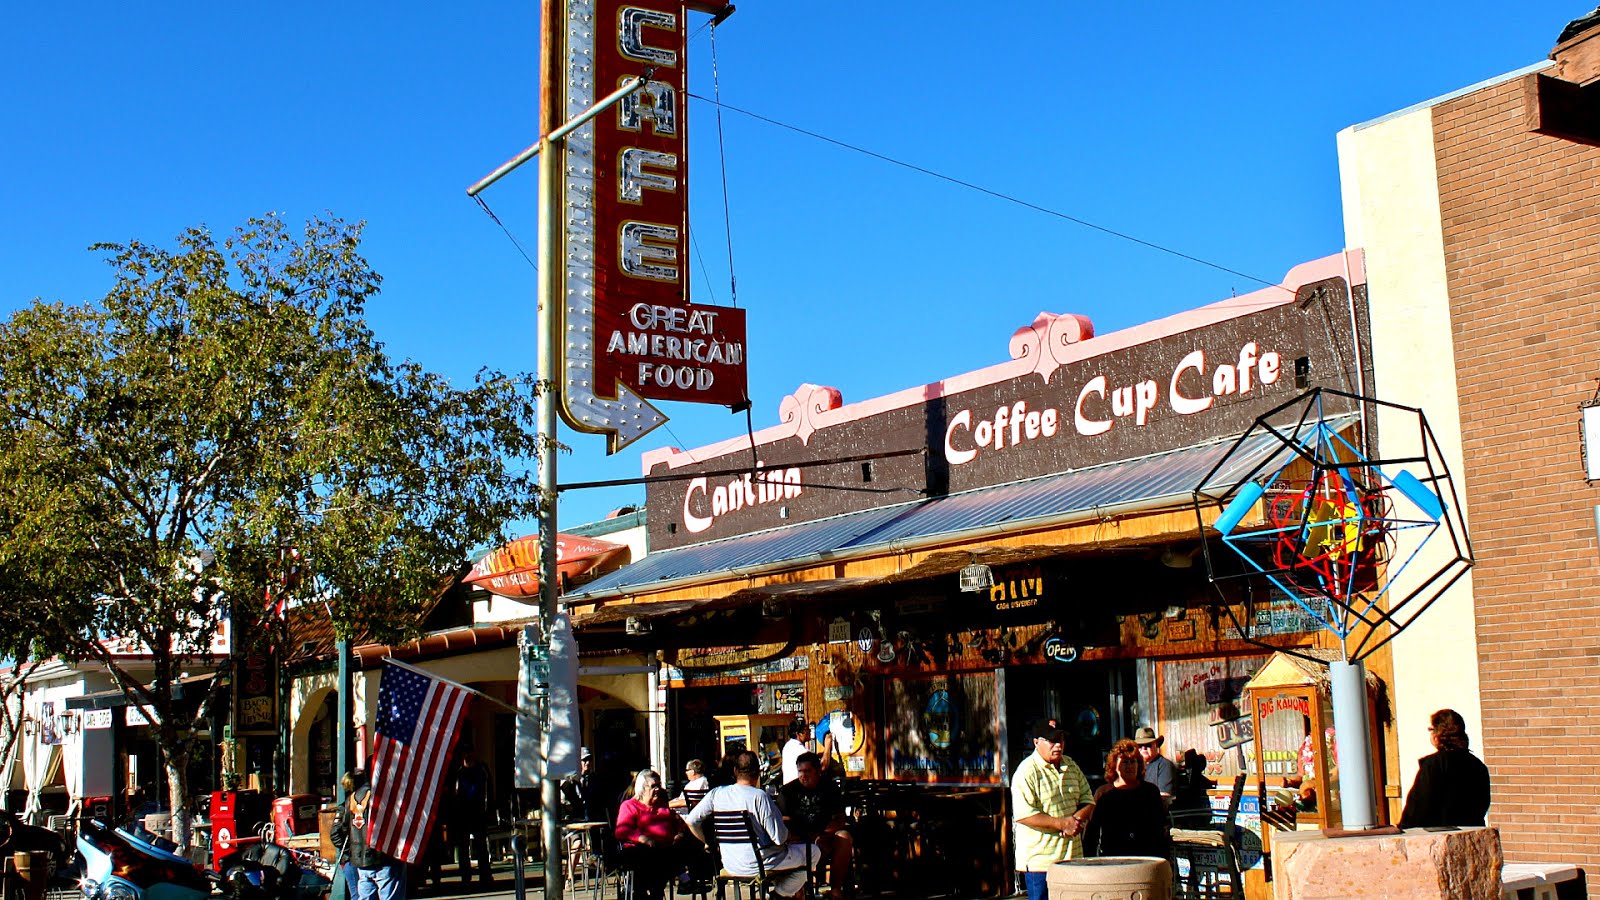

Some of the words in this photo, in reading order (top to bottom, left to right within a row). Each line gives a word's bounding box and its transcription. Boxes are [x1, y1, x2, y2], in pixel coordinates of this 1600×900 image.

[617, 4, 679, 283] CAFE
[629, 303, 719, 334] GREAT
[606, 330, 743, 367] AMERICAN
[638, 362, 715, 392] FOOD
[944, 400, 1058, 465] Coffee
[1074, 375, 1159, 436] Cup
[1169, 341, 1281, 415] Cafe
[683, 460, 803, 534] Cantina
[477, 539, 566, 578] ANTIQUS
[1261, 699, 1275, 719] BIG
